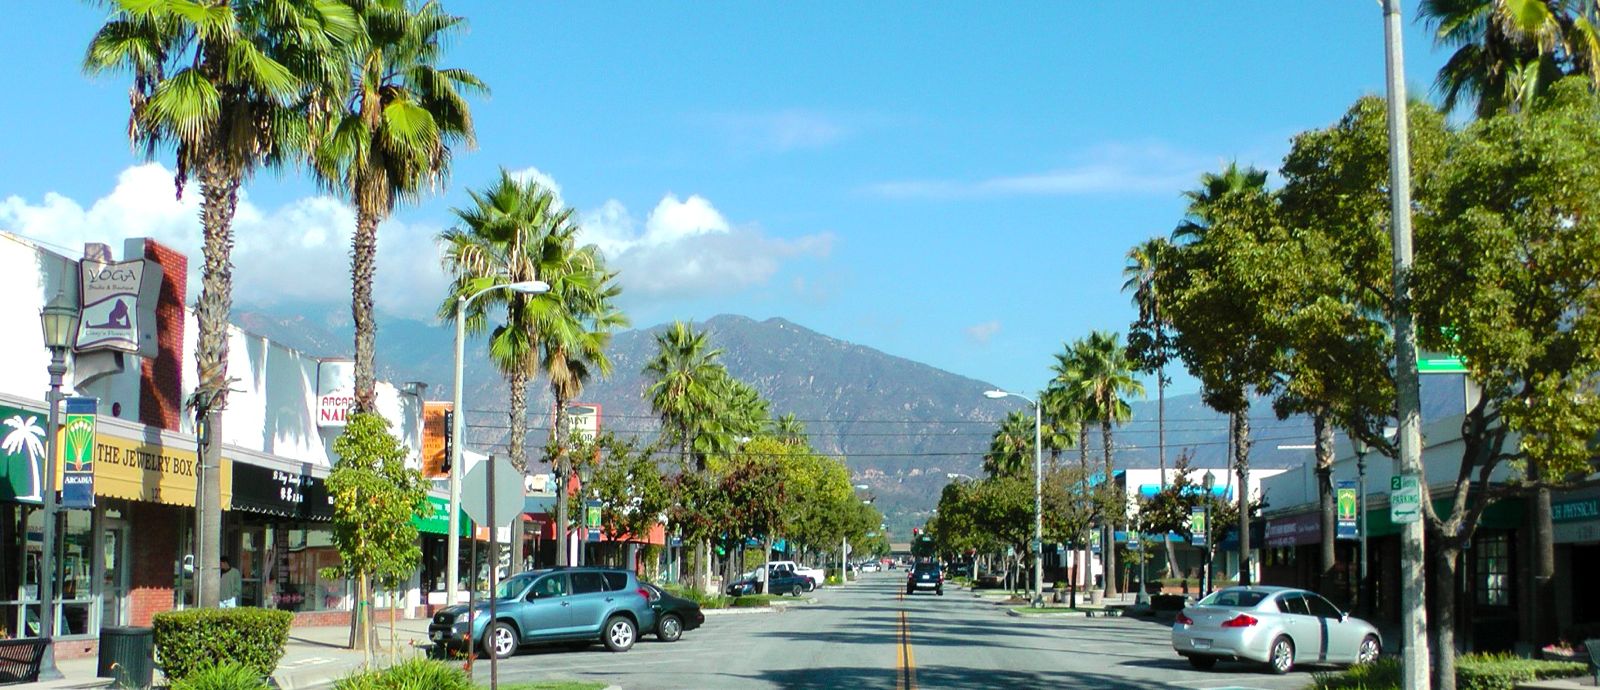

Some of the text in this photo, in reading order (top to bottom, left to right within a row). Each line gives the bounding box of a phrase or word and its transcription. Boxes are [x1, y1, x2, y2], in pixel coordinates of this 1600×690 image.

[89, 269, 136, 283] YOGA
[322, 397, 353, 406] ARCA
[321, 409, 346, 421] NAI
[569, 416, 588, 425] AINT
[97, 444, 120, 464] THE
[123, 449, 171, 473] JEWELRY
[173, 458, 193, 477] BOX
[64, 476, 93, 484] ARCADIA
[1393, 478, 1400, 489] 2
[1392, 494, 1418, 505] PARKING
